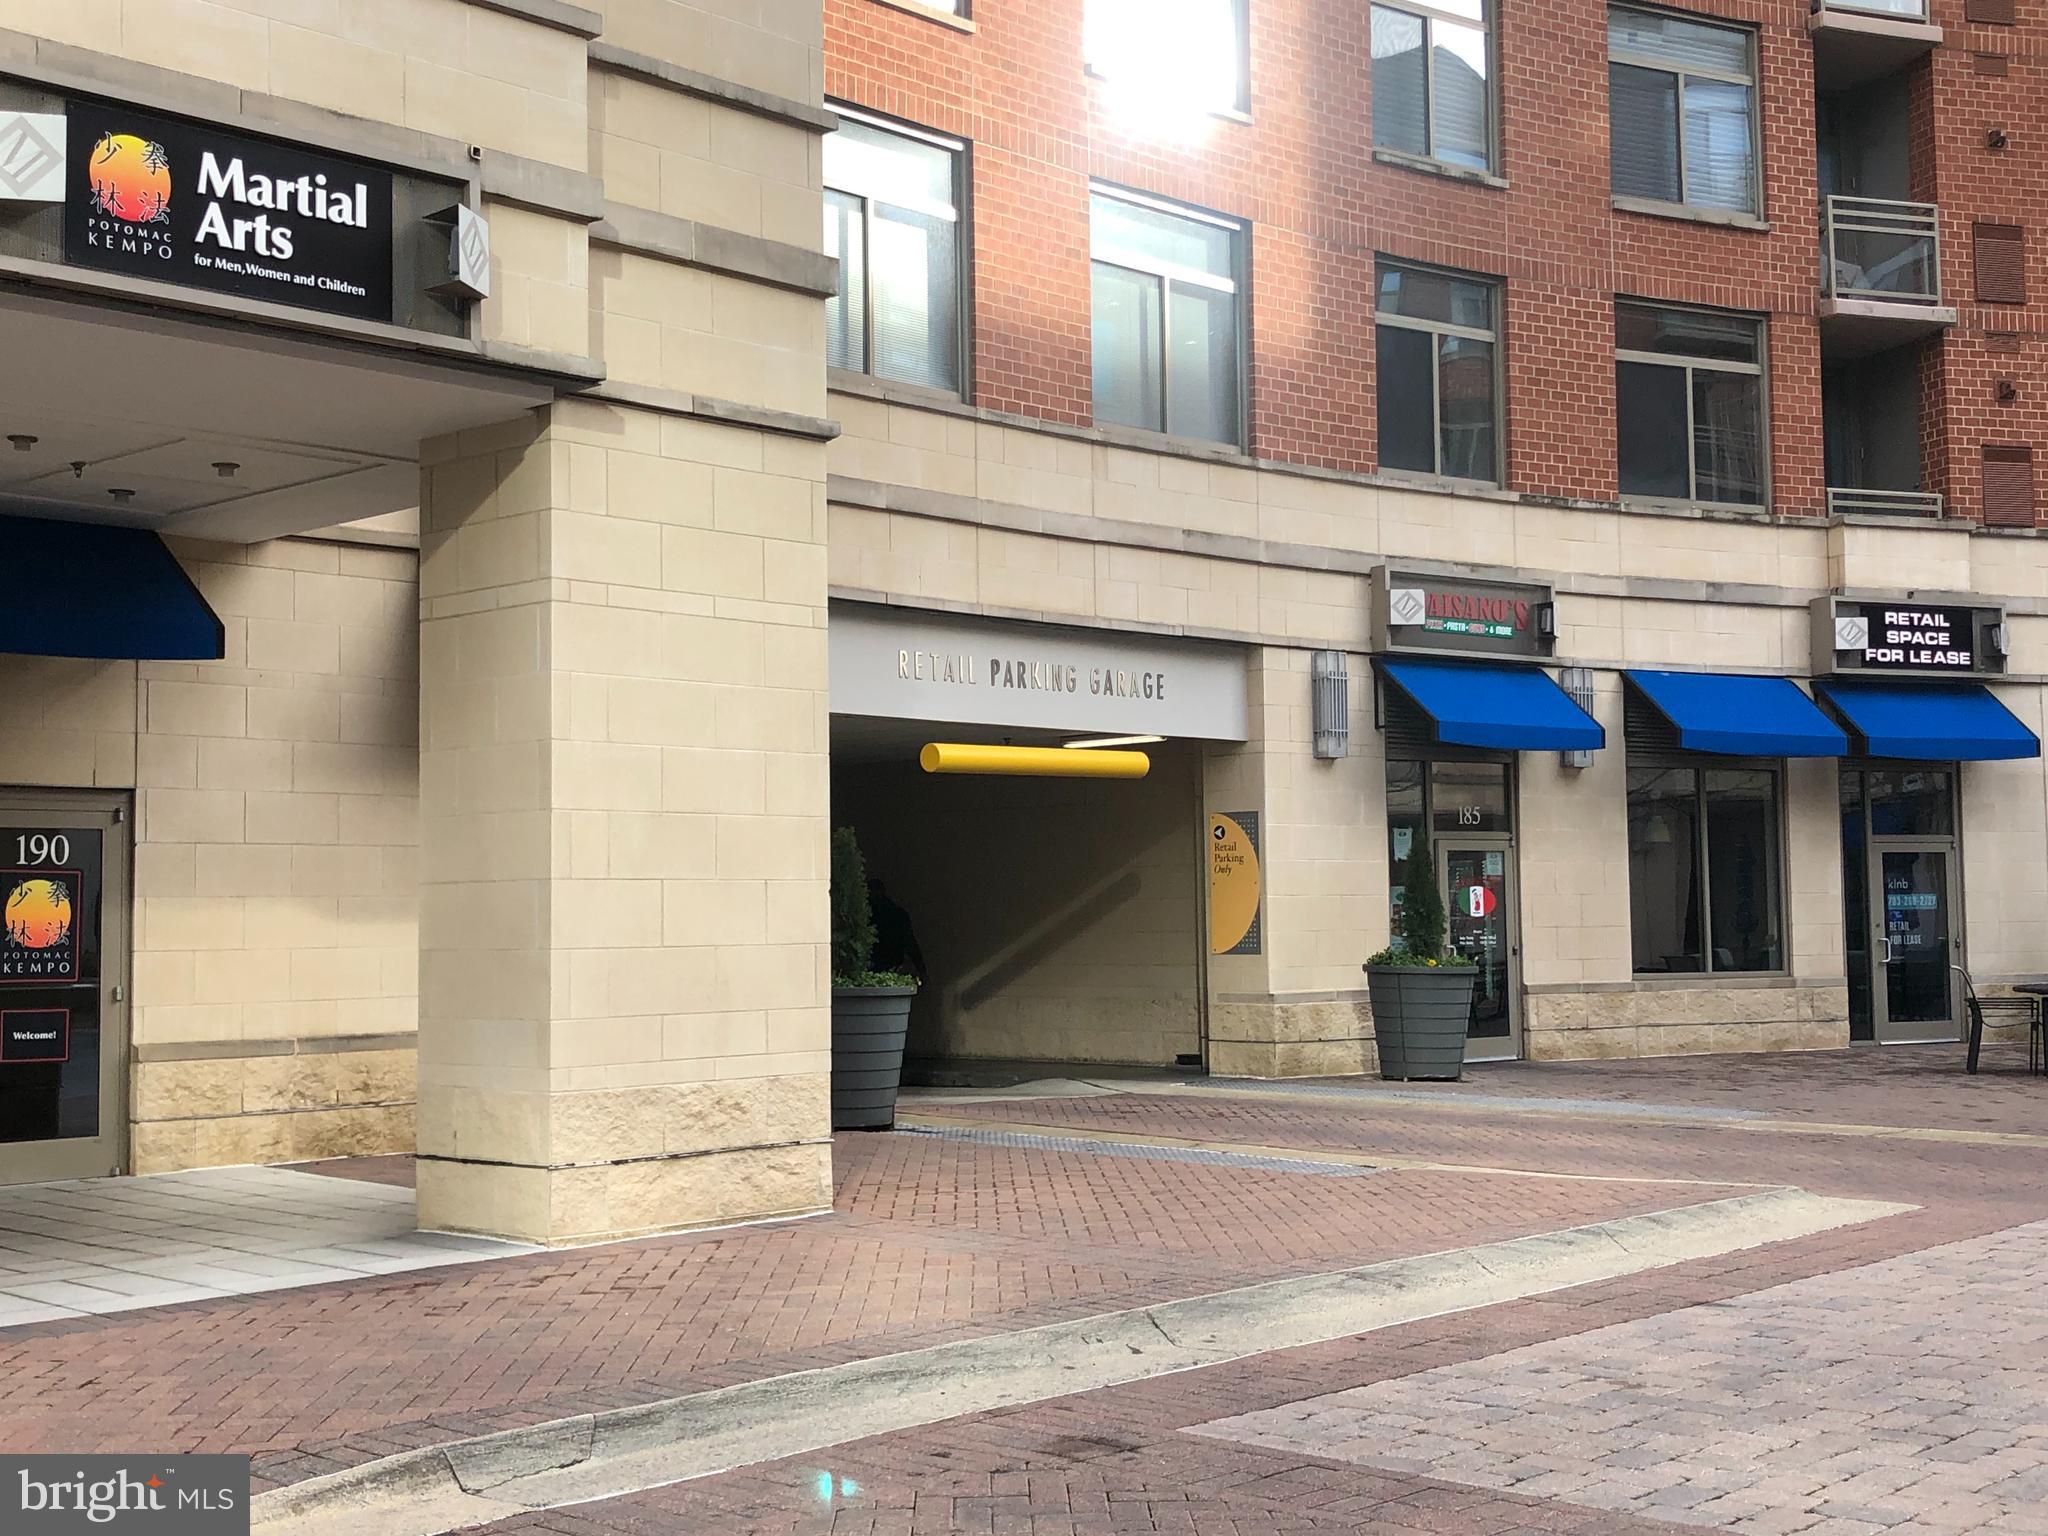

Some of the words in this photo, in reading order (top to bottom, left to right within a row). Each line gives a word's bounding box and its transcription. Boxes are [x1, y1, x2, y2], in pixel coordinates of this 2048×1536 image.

[197, 152, 367, 228] Martial
[88, 218, 173, 243] POTOMAC
[195, 202, 294, 260] Arts
[88, 232, 173, 260] KEMPO
[194, 254, 212, 267] for
[293, 276, 315, 287] and
[317, 278, 366, 297] Children
[1425, 593, 1528, 631] AISANO'S
[1885, 612, 1950, 627] RETAIL
[1886, 631, 1950, 646] SPACE
[1865, 648, 1904, 662] FOR
[1910, 650, 1971, 665] LEASE
[898, 648, 976, 685] RETAIL
[990, 658, 1077, 693] PARKING
[1090, 667, 1164, 700] GARAGE
[1458, 806, 1480, 825] 185
[15, 834, 70, 866] 190
[1214, 842, 1237, 852] Retail
[1214, 853, 1244, 865] Parking
[1214, 864, 1232, 876] Only
[1889, 921, 1910, 931] RETAIL
[1890, 935, 1902, 945] FOR
[1904, 934, 1922, 945] LEASE
[4, 951, 70, 960] POTOMAC
[4, 961, 70, 973] KEMPO
[13, 1031, 56, 1040] Welcome!
